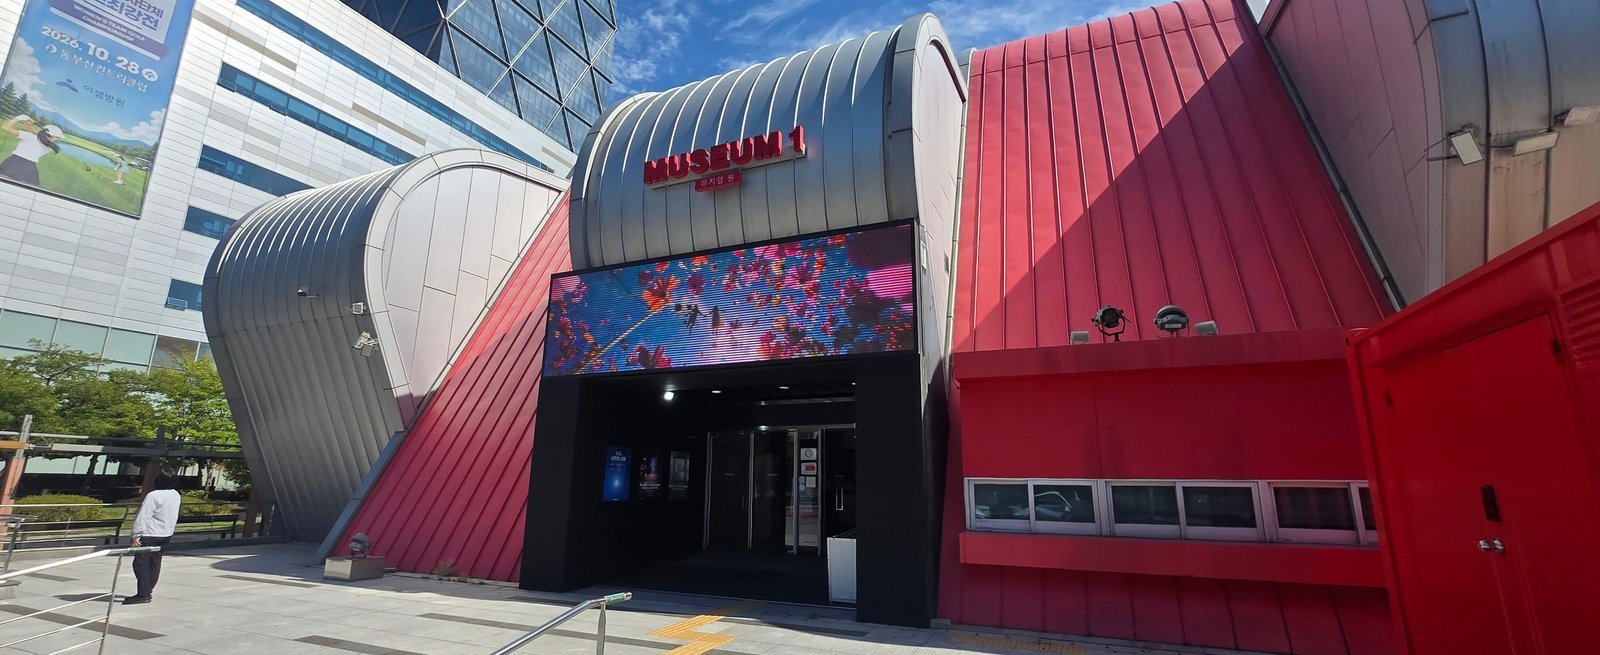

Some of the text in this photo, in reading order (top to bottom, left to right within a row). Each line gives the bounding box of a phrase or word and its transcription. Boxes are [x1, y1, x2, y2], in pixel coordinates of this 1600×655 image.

[82, 15, 135, 41] CHAMPIONSHIP
[95, 0, 158, 31] 최강전
[108, 21, 127, 33] TEAM
[127, 30, 145, 41] GOLF
[41, 26, 83, 51] 2026.
[87, 43, 111, 63] 10.
[115, 56, 139, 75] 28
[644, 124, 805, 184] MUSEUM 1
[701, 173, 735, 188] 뮤지엄 원
